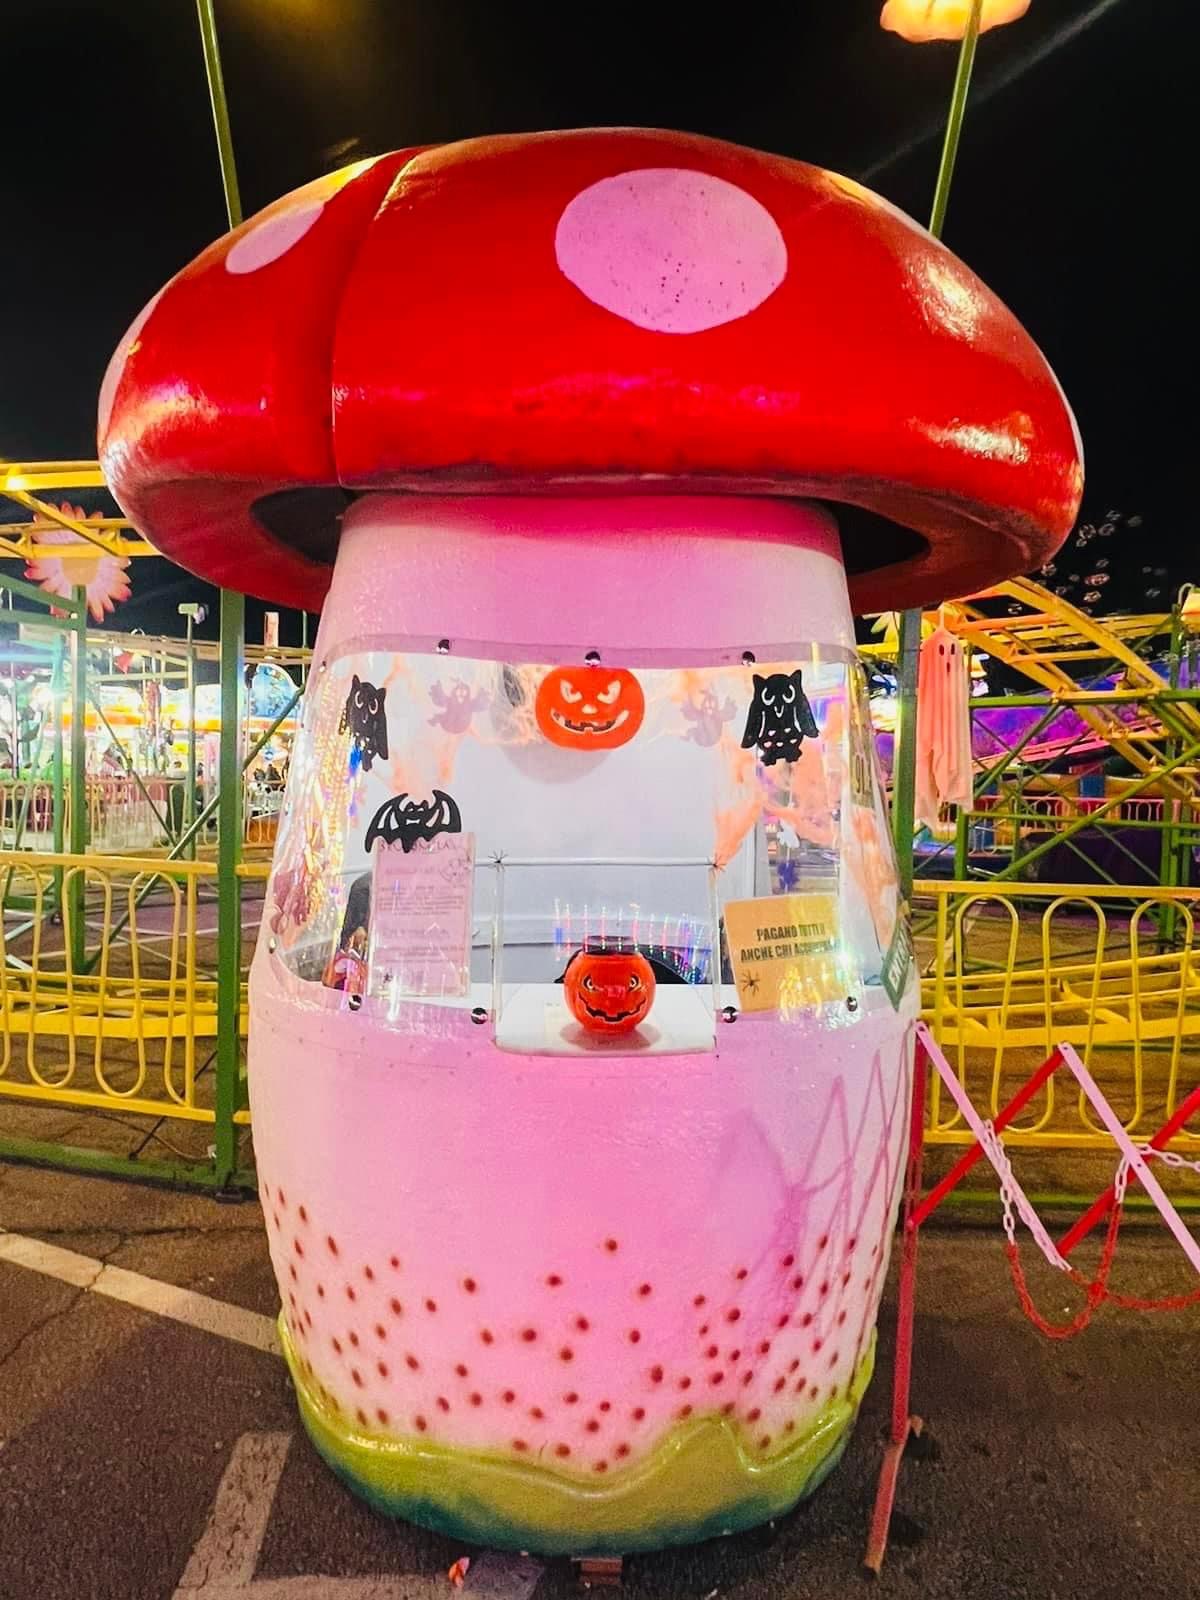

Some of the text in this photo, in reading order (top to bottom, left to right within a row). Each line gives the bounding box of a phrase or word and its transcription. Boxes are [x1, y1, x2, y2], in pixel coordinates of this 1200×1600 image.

[756, 925, 798, 941] PAGANO
[740, 945, 774, 963] ANCHE
[774, 943, 793, 958] CHI
